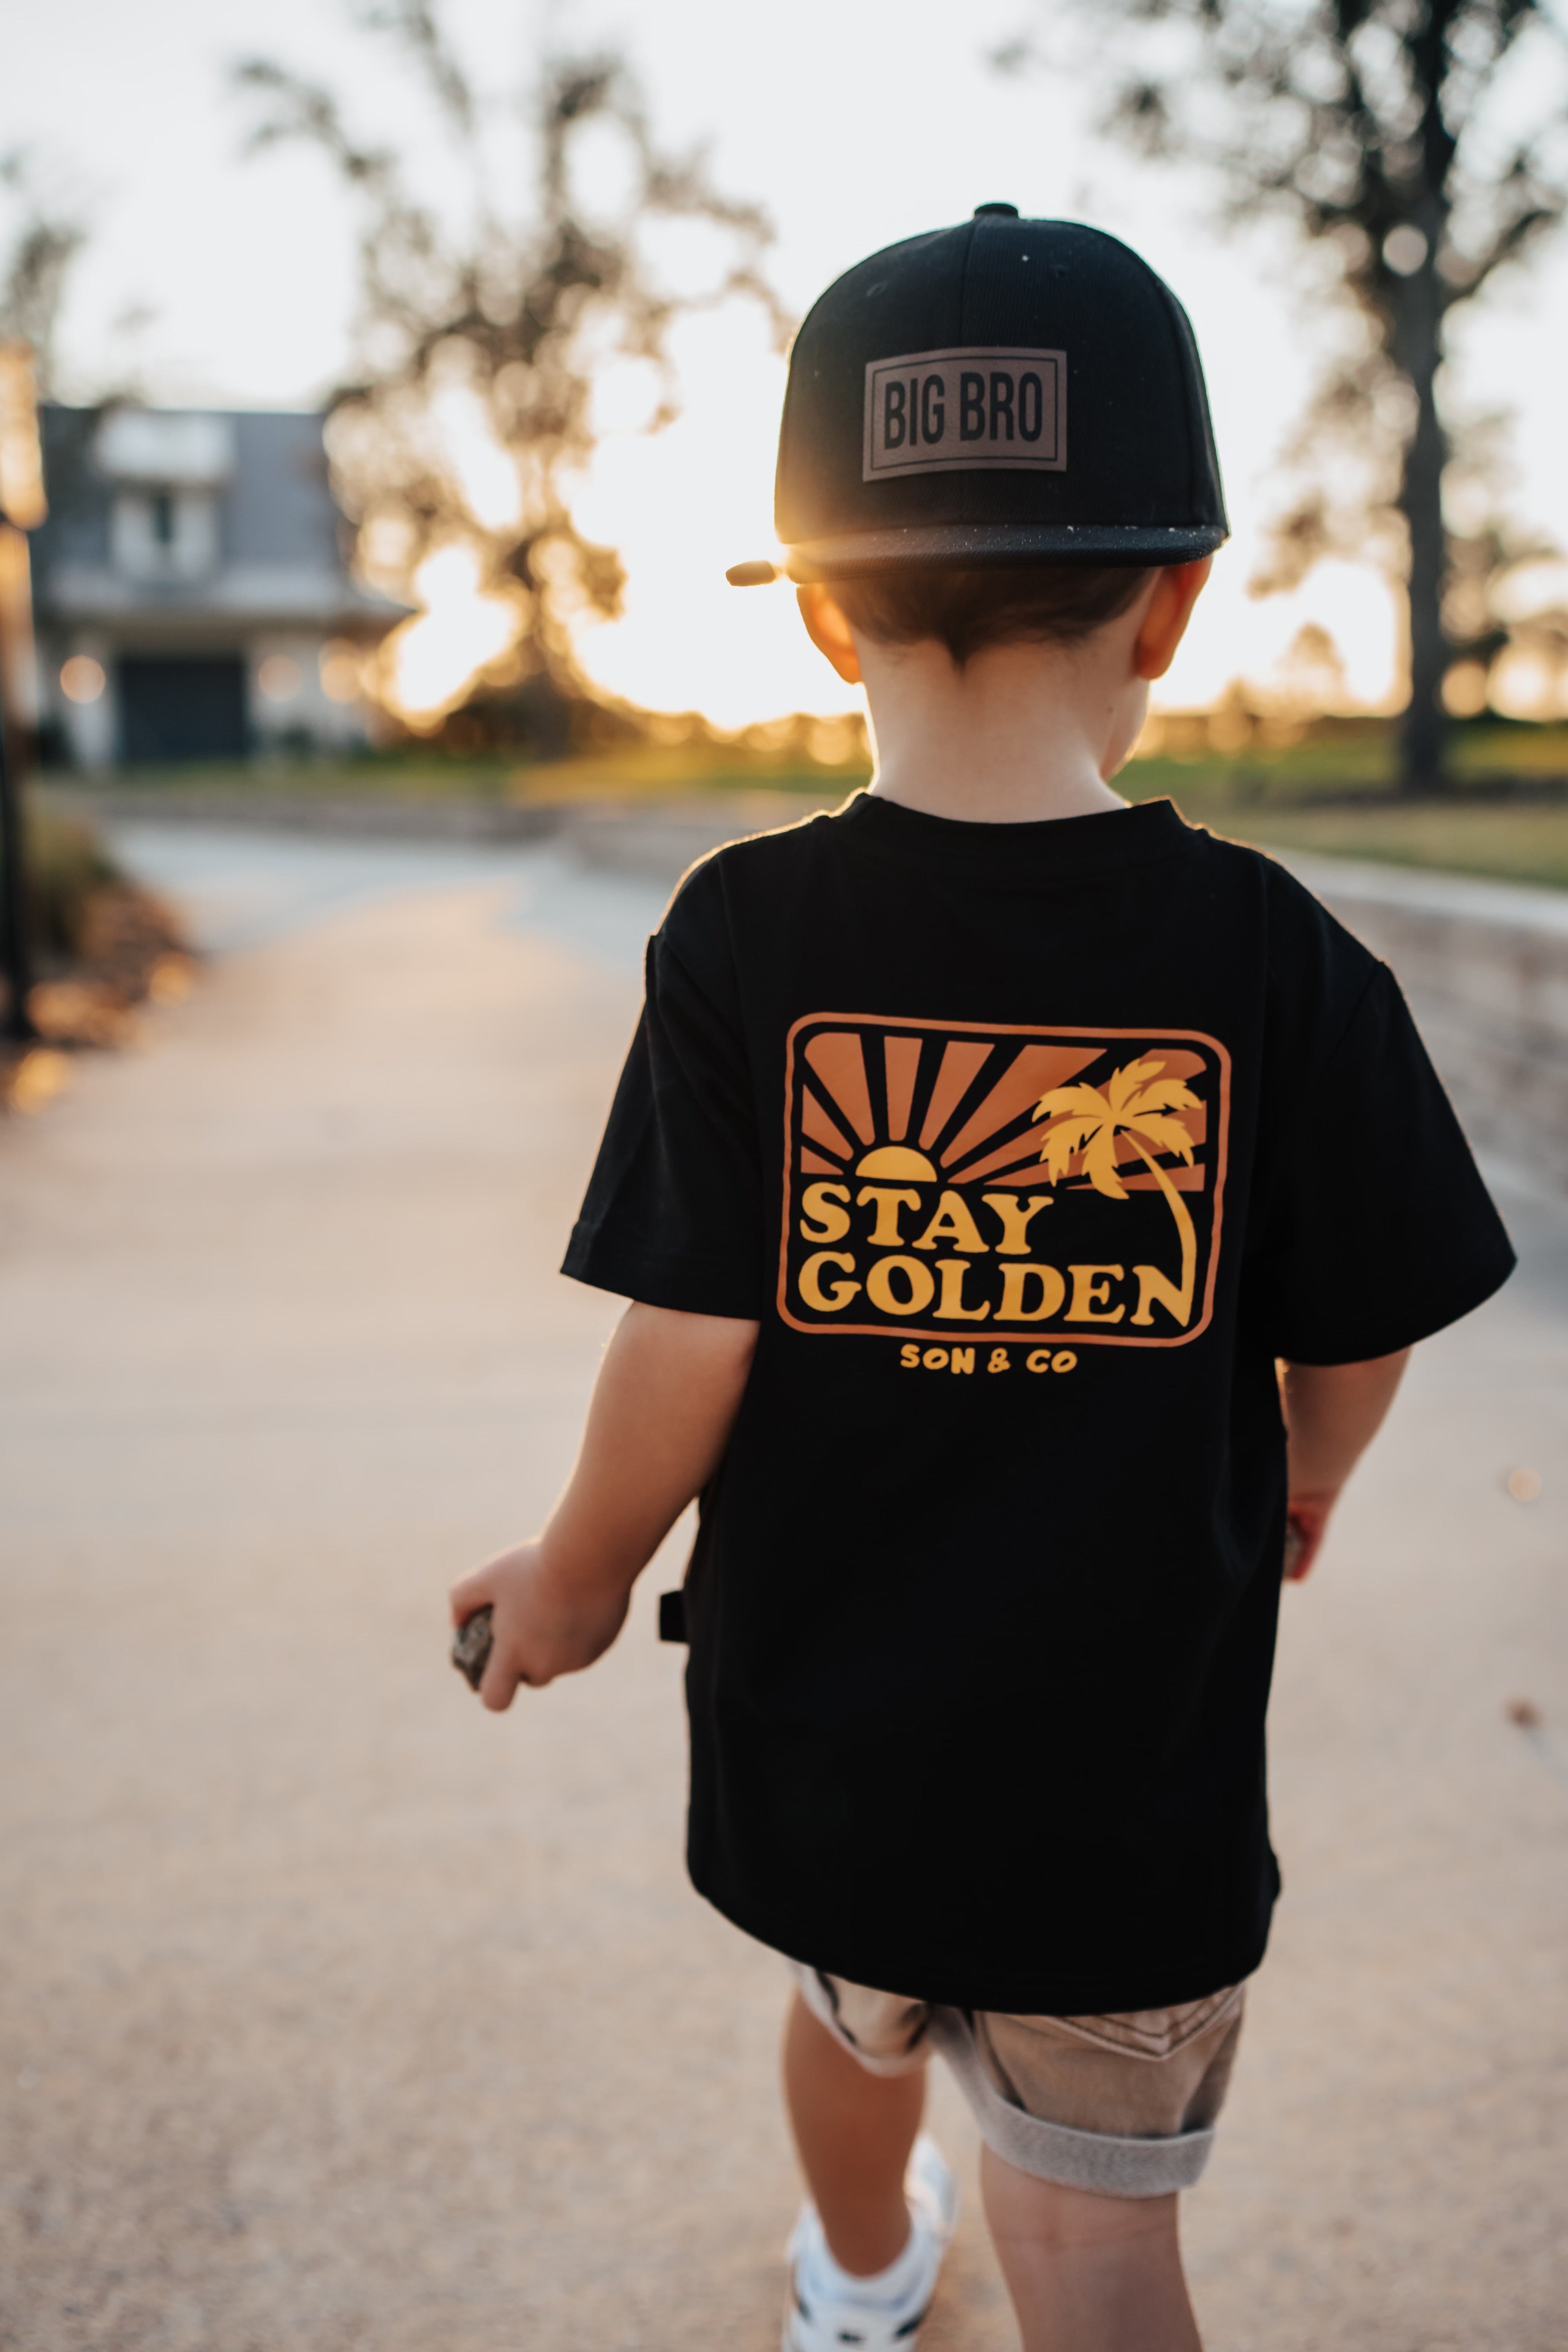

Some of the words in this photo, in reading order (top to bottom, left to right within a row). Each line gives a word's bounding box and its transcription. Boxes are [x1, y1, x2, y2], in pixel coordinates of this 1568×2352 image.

[884, 374, 945, 450] BIG
[960, 372, 1042, 442] BRO
[800, 1182, 1054, 1255] STAY
[798, 1250, 1196, 1327] GOLDEN
[900, 1344, 976, 1374] SON
[987, 1347, 1011, 1373] &
[1026, 1349, 1078, 1373] CO
